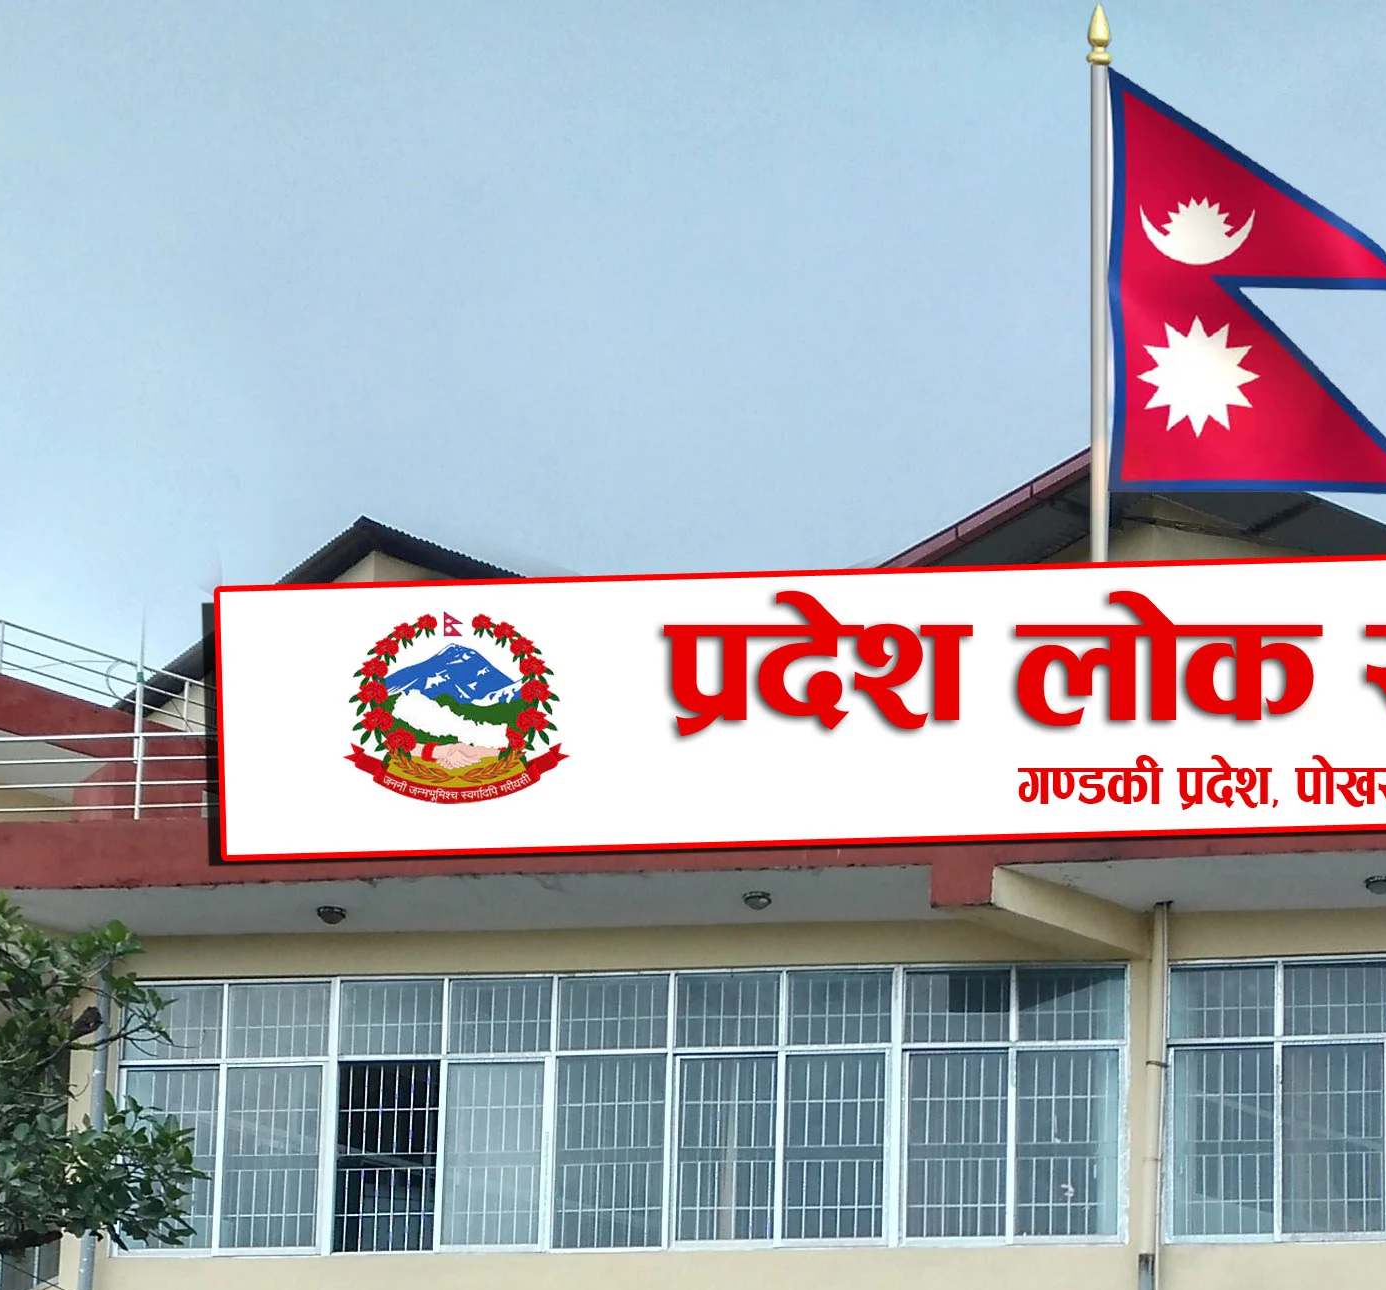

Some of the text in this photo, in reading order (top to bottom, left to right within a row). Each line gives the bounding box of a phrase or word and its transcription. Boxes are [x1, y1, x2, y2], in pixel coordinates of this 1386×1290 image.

[663, 591, 973, 735] प्रदेश
[1015, 591, 1323, 726] लोक
[382, 775, 408, 792] जननी
[1018, 755, 1163, 804] गण्डकी
[1177, 755, 1280, 810] प्रदेश,
